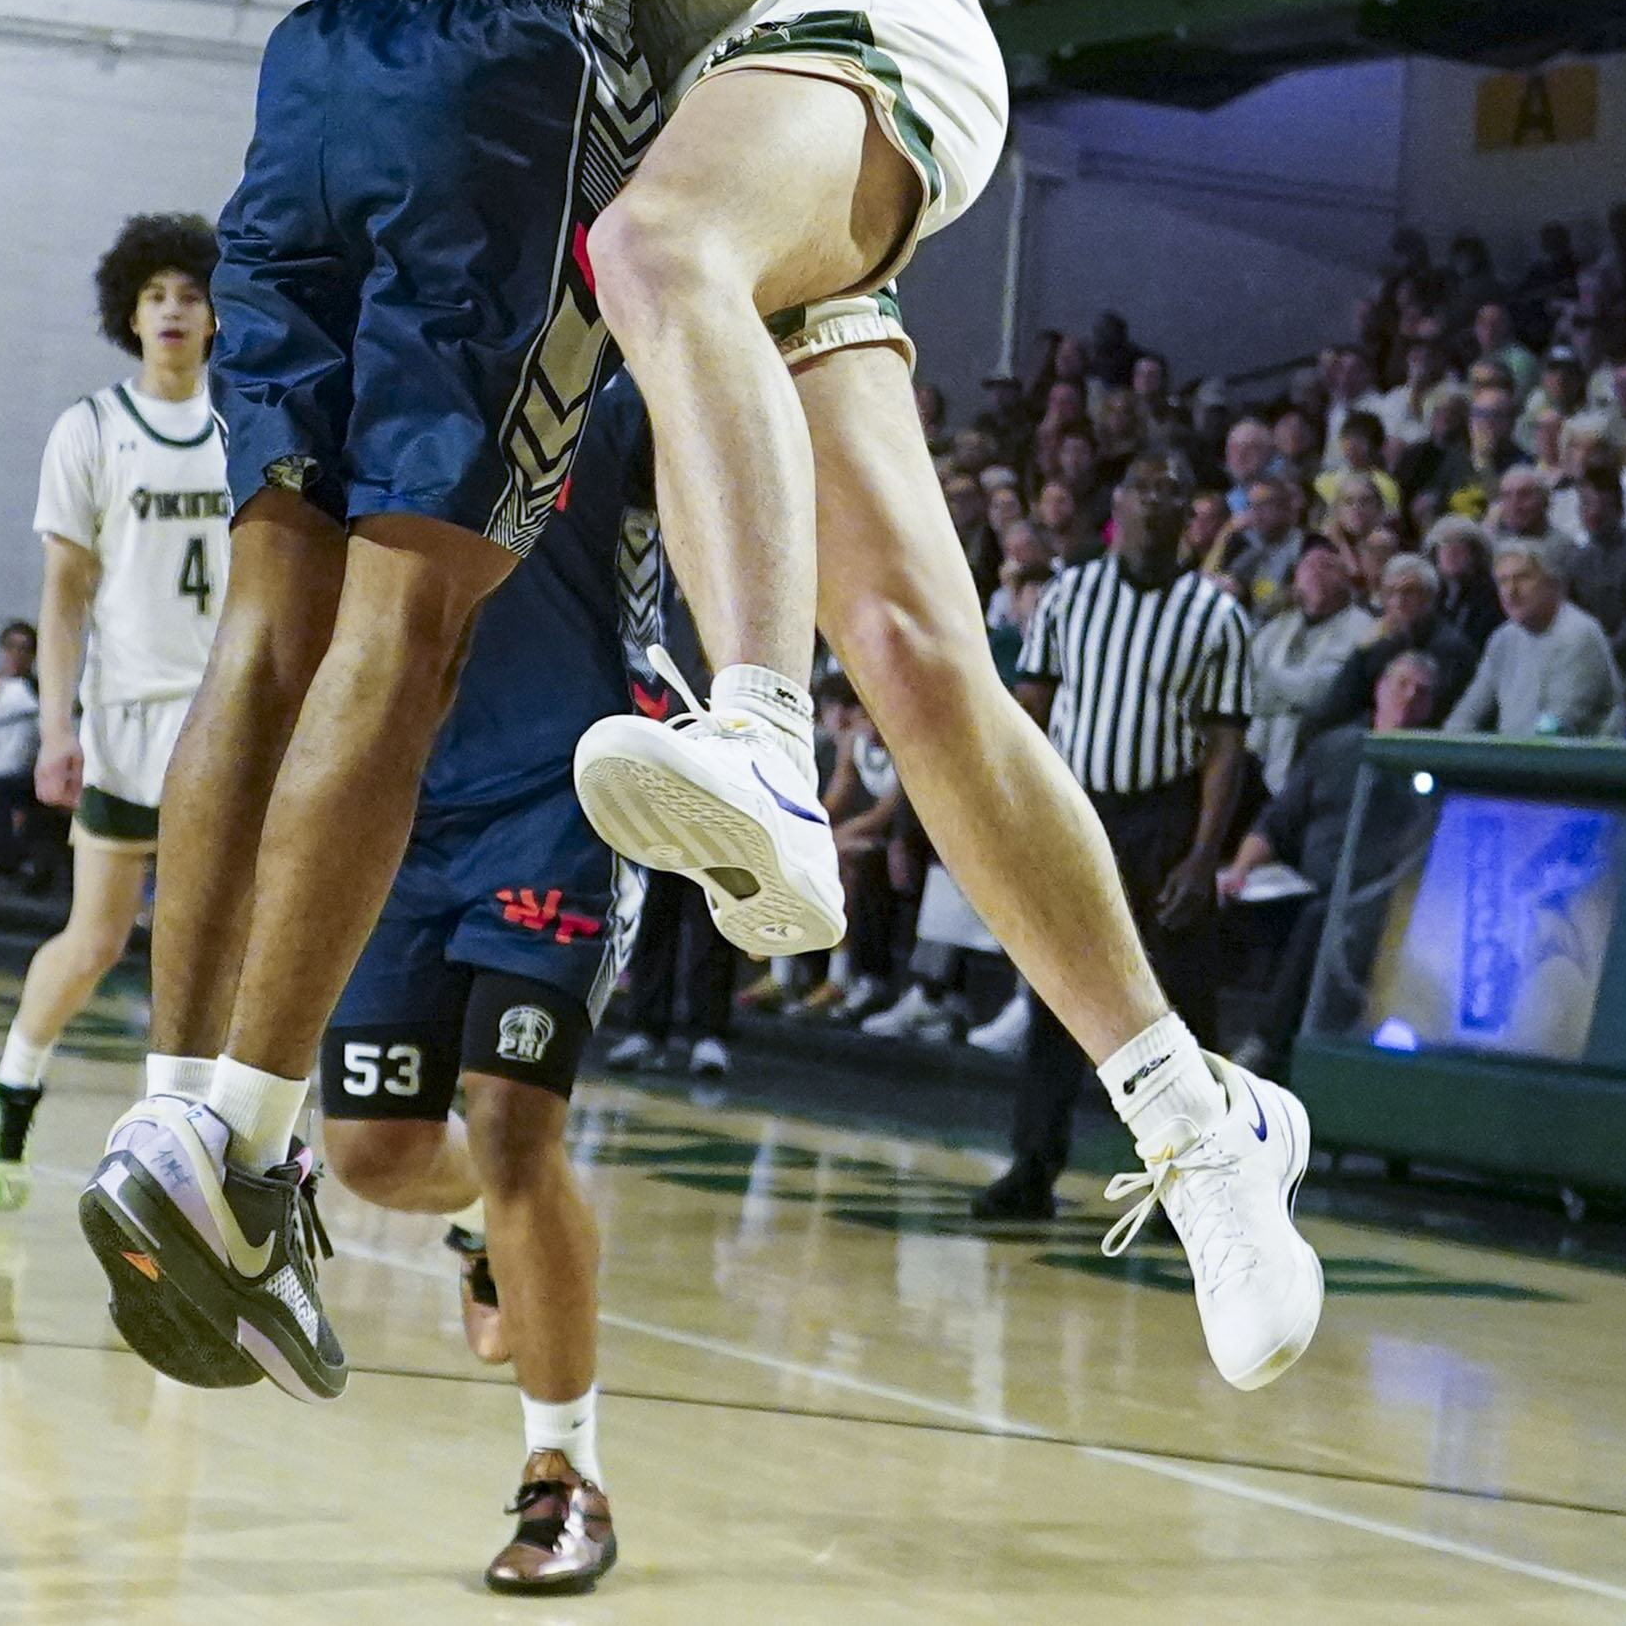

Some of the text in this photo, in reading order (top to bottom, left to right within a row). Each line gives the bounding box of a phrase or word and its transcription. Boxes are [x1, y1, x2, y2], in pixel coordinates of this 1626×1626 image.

[1510, 73, 1557, 146] A
[177, 532, 213, 616] 4
[342, 1039, 422, 1097] 53
